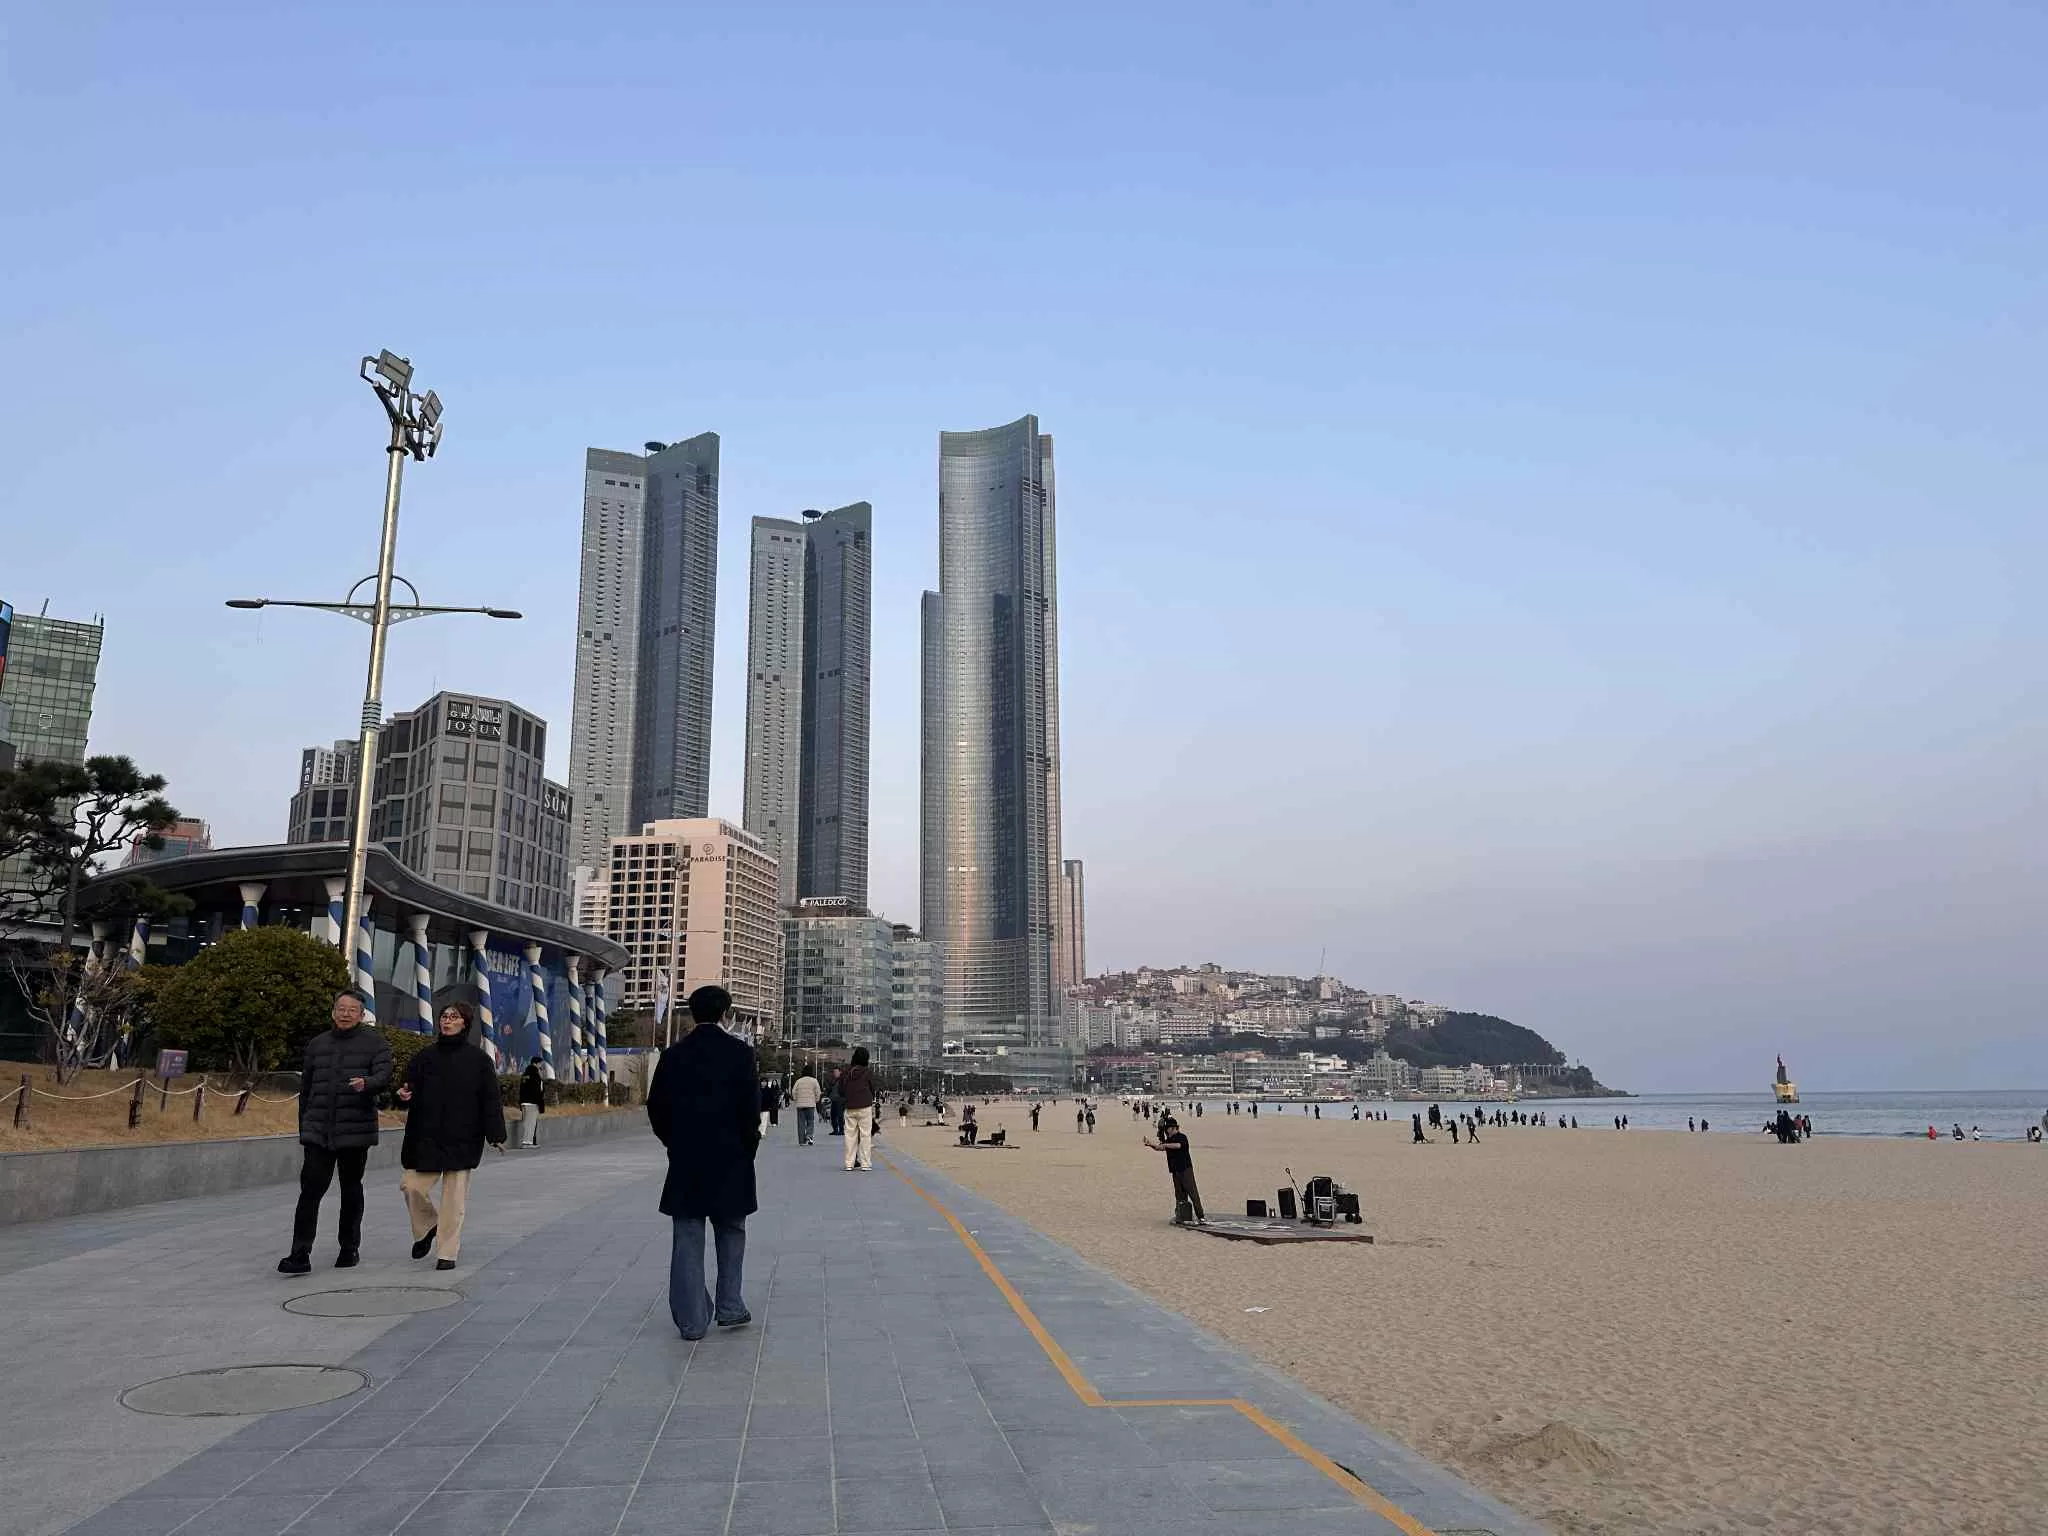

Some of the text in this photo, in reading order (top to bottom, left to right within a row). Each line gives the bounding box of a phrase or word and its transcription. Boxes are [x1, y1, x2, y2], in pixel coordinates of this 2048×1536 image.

[449, 710, 502, 724] GRAND
[447, 719, 501, 735] JOSUN
[544, 794, 568, 816] SUN
